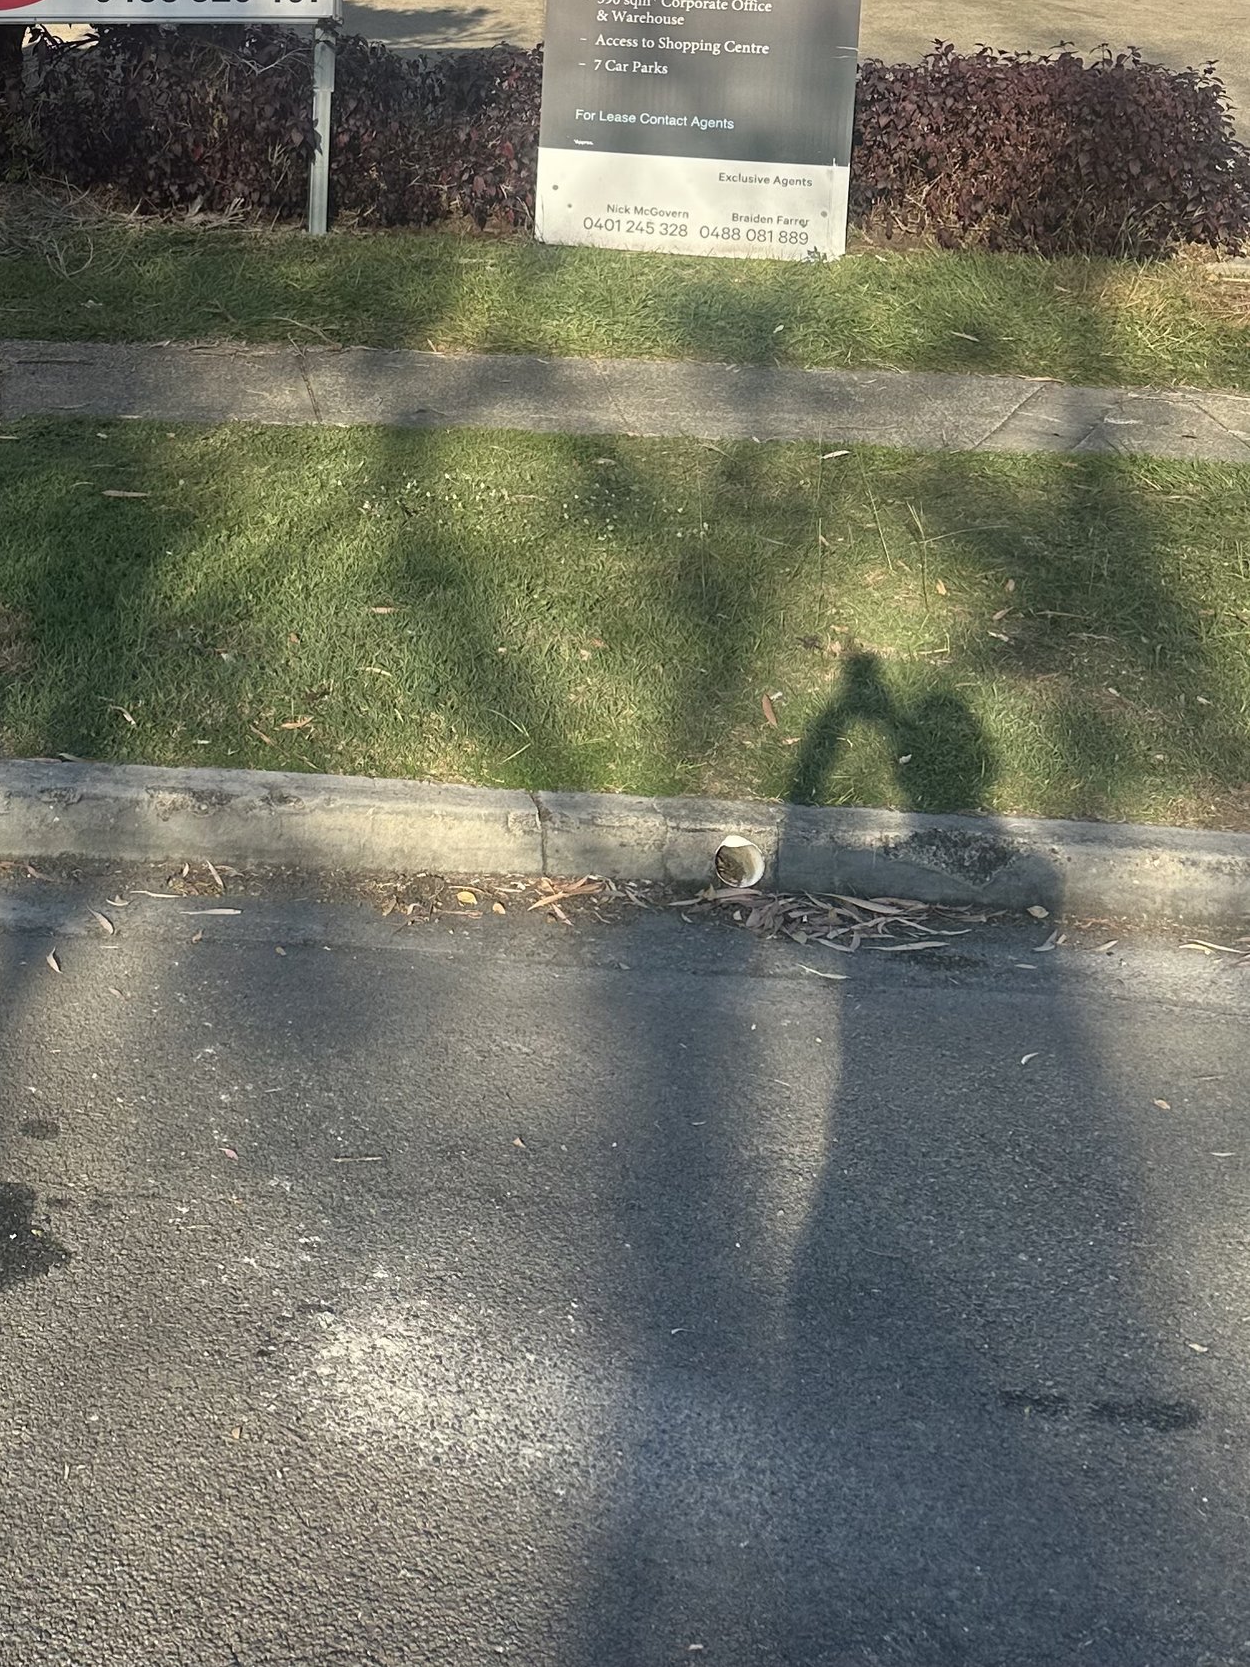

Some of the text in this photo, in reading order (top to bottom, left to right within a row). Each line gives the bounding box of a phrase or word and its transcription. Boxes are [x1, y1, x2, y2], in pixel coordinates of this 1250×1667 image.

[596, 9, 685, 25] & Warehouse
[595, 34, 770, 55] Access to Shopping Centre
[594, 60, 668, 74] 7 Car Parks
[575, 108, 735, 130] For Lease Contact Agents
[718, 172, 813, 187] Exclusive Agents
[606, 203, 689, 219] Nick McGovern
[731, 212, 774, 225] Braiden
[583, 217, 809, 245] 0401 245 328 0488 081 889
